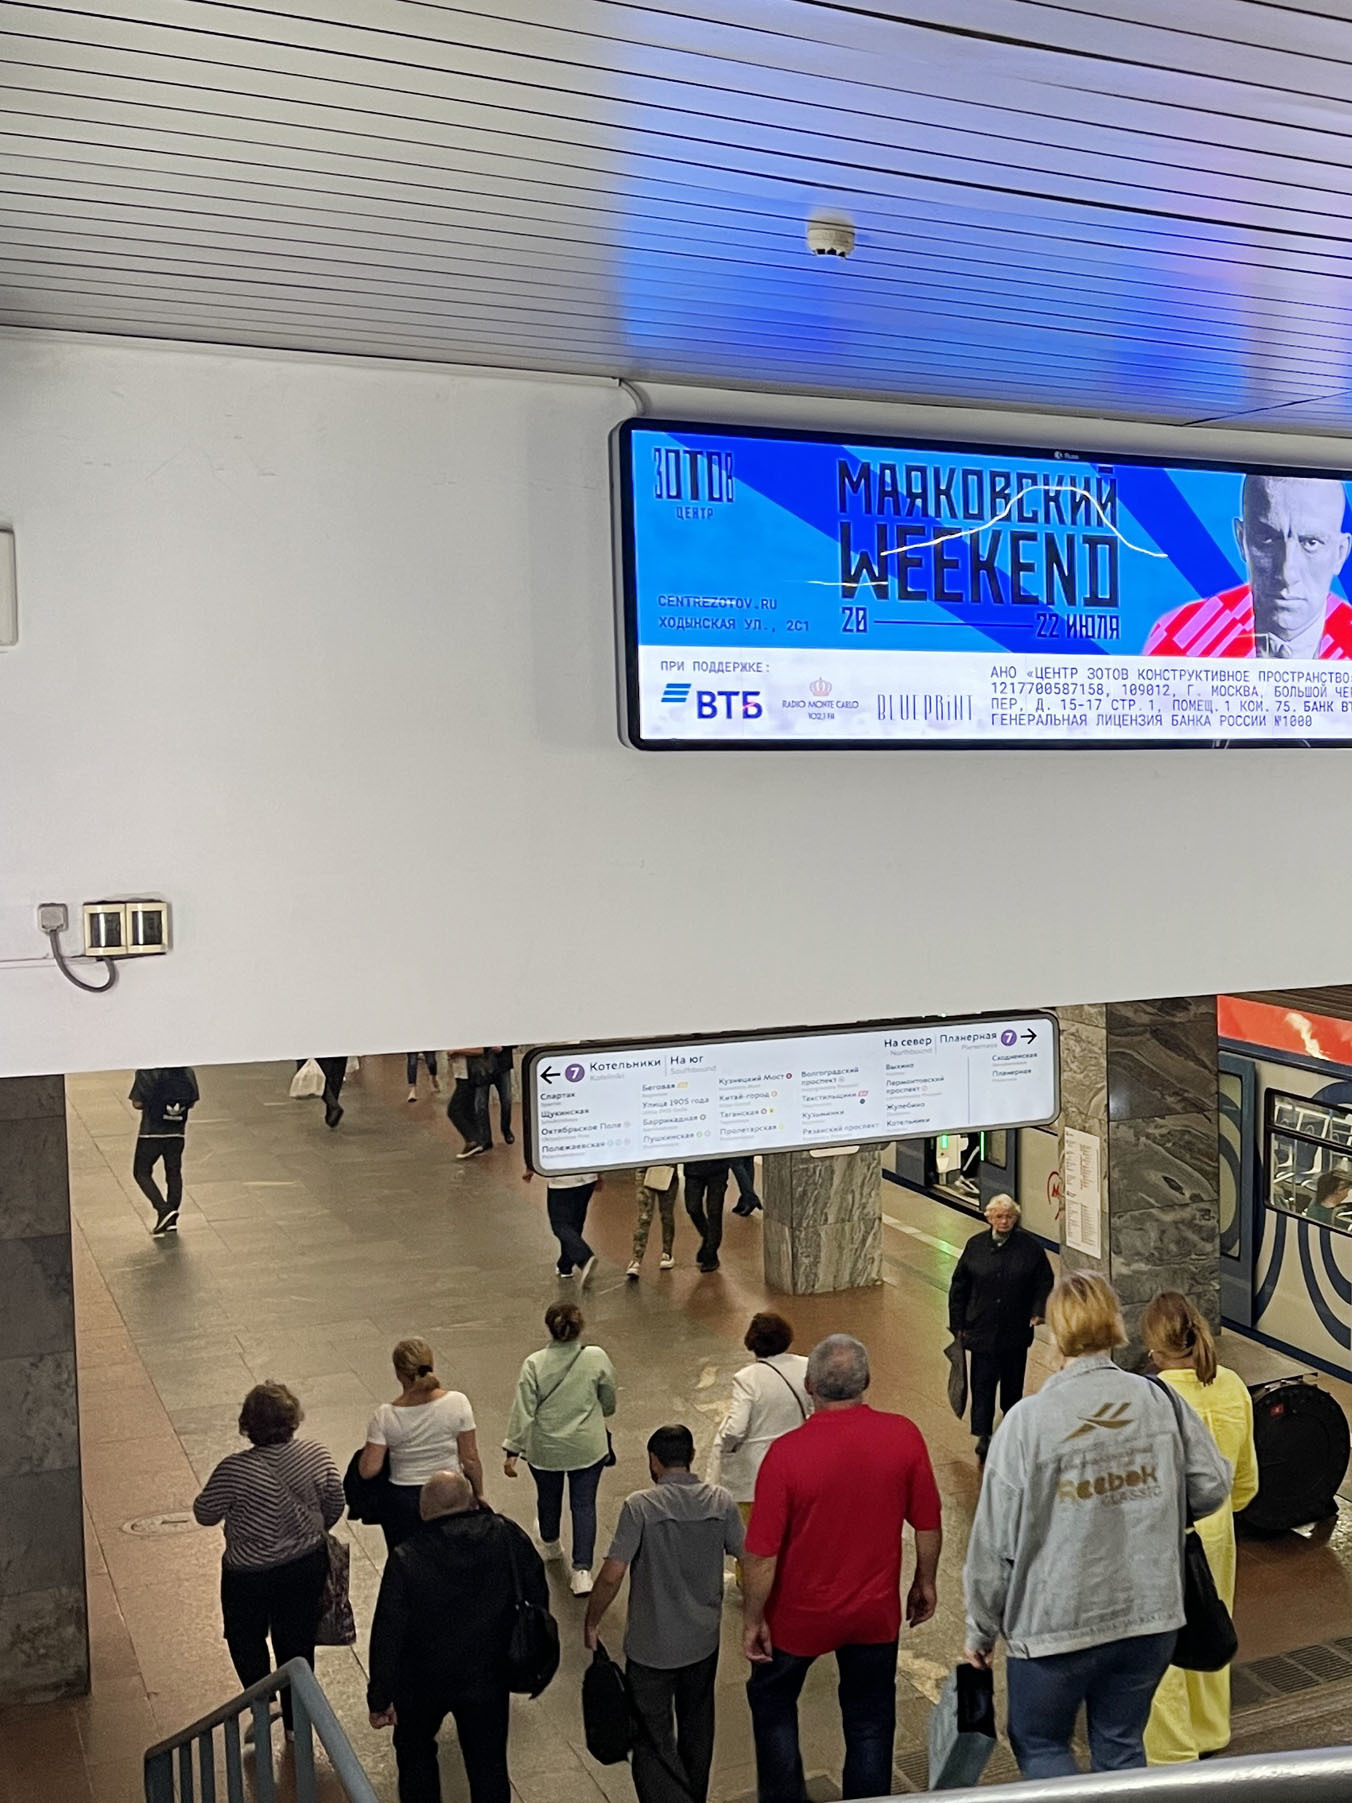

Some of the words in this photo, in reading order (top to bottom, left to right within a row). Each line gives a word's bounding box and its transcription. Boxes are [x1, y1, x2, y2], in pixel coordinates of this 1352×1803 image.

[653, 447, 734, 503] ЗОТОВ
[838, 459, 1117, 528] МАЯКОВСКИЙ
[676, 506, 713, 520] ЦЕНТР
[840, 521, 1119, 608] WEEKEND
[658, 595, 777, 610] CENTREZOTOV.RU
[659, 617, 736, 630] ХОДЫНСКАЯ
[842, 606, 867, 633] 20
[1036, 612, 1059, 638] 22
[1066, 614, 1119, 639] ИЮЛЯ
[661, 661, 685, 671] ПРИ
[693, 661, 770, 674] ПОДДЕРЖКЕ:
[991, 666, 1017, 679] АНО
[1027, 667, 1078, 681] «ЦЕНТР
[1087, 667, 1129, 680] ЗОТОВ
[1138, 668, 1250, 682] КОНСТРУКТИВНОЕ
[992, 682, 1110, 698] 1217700587158,
[1122, 683, 1176, 698] 109012,
[1187, 684, 1201, 697] Г.
[1212, 685, 1263, 699] МОСКВА,
[1274, 683, 1327, 698] БОЛЬШОЙ
[696, 690, 763, 719] ВТБ
[782, 700, 807, 709] RADIO
[808, 700, 834, 709] MONTE
[1035, 698, 1050, 713] Д.
[1060, 698, 1102, 711] 15-17
[1303, 700, 1334, 713] БАНК
[991, 713, 1087, 726] ГЕНЕРАЛЬНАЯ
[1096, 713, 1163, 728] ЛИЦЕНЗИЯ
[1171, 714, 1211, 727] БАНКА
[1220, 715, 1266, 727] РОССИИ
[884, 1039, 898, 1048] На
[901, 1037, 932, 1047] север
[940, 1031, 997, 1044] Планерная
[1004, 1032, 1013, 1044] 7
[670, 1056, 686, 1065] На
[689, 1055, 704, 1064] юг
[570, 1067, 580, 1079] 7
[590, 1059, 661, 1072] Котельники
[763, 1073, 785, 1081] Мост
[669, 1098, 690, 1106] 1905
[691, 1097, 710, 1105] года
[600, 1122, 622, 1130] Поле
